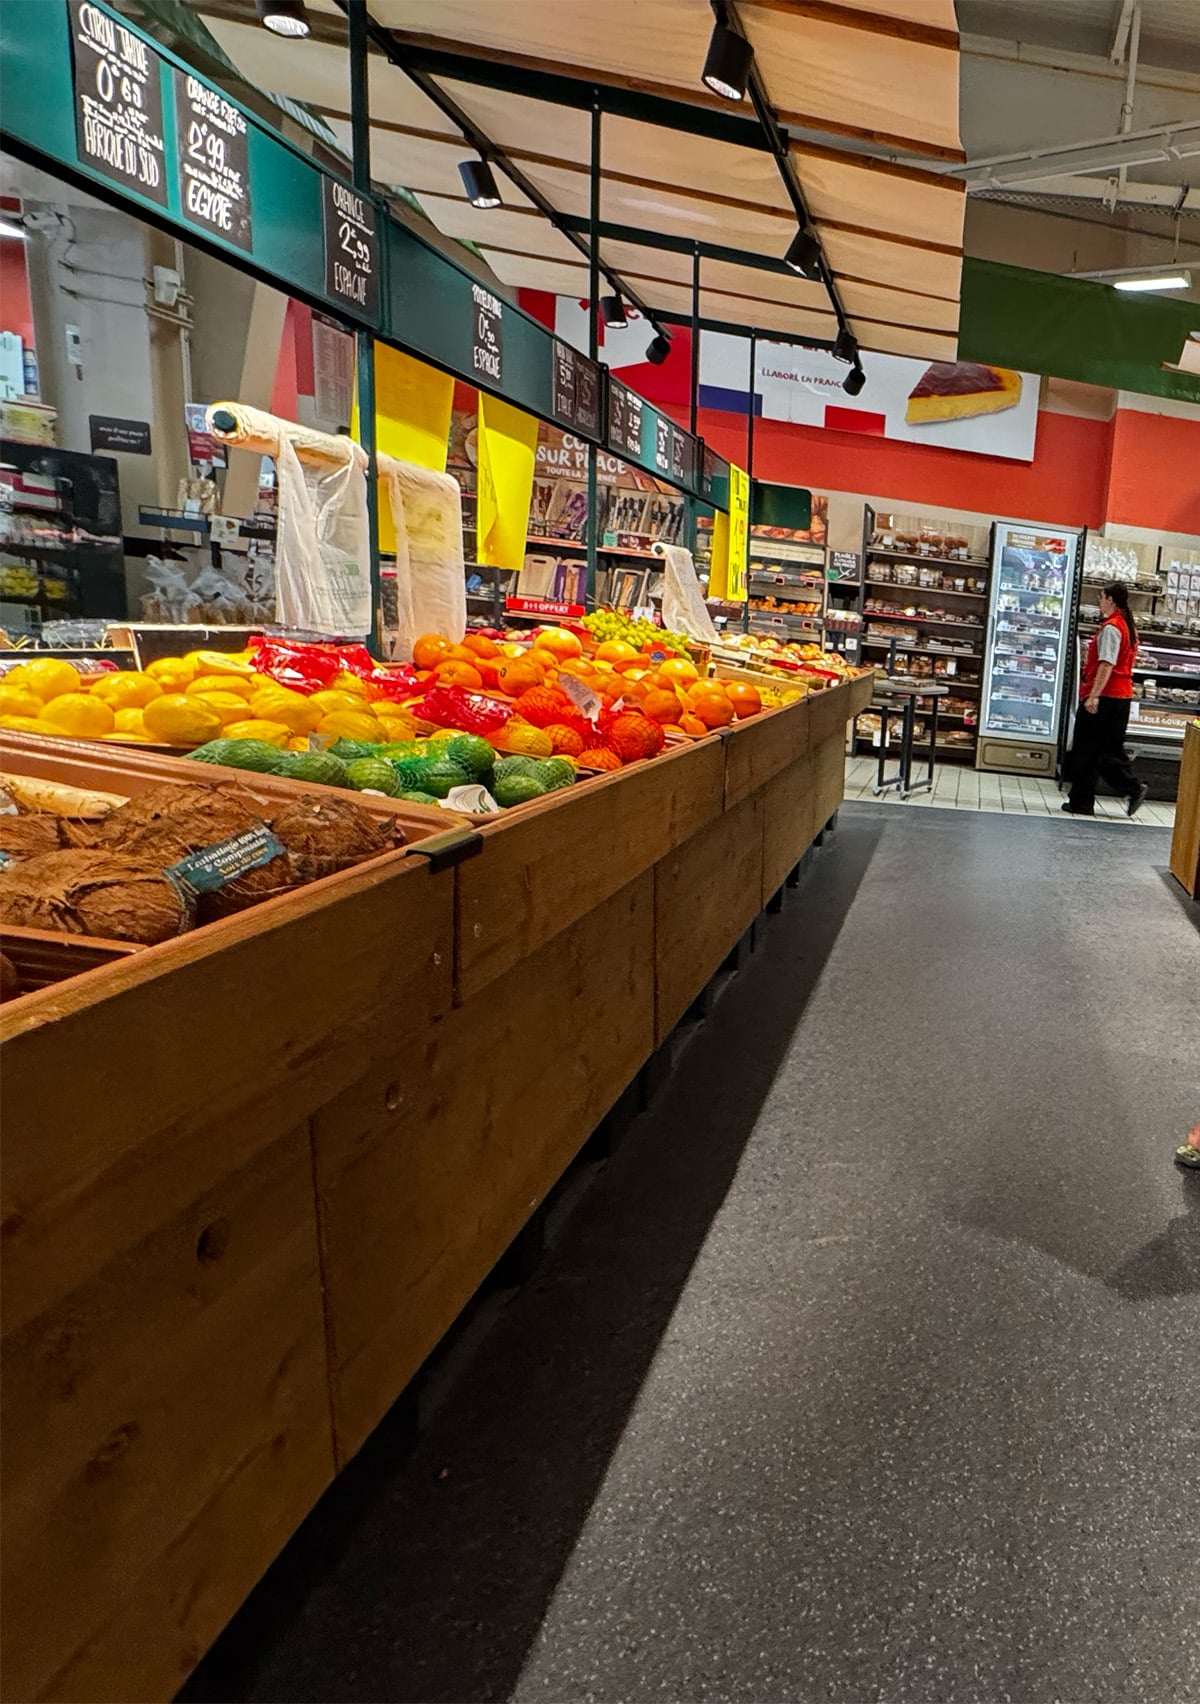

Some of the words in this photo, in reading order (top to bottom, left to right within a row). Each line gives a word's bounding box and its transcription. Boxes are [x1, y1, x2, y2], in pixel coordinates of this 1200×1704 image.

[84, 116, 124, 169] AFRIQUE
[125, 138, 137, 175] DU
[139, 147, 159, 187] SUD
[187, 178, 233, 230] EGYPTE
[333, 182, 365, 224] ORANGE
[334, 261, 367, 306] ESPAGNE
[801, 375, 812, 383] EN
[814, 377, 842, 388] FRANC
[536, 445, 571, 467] SUR
[546, 466, 570, 476] TOUTE
[571, 470, 581, 478] LA
